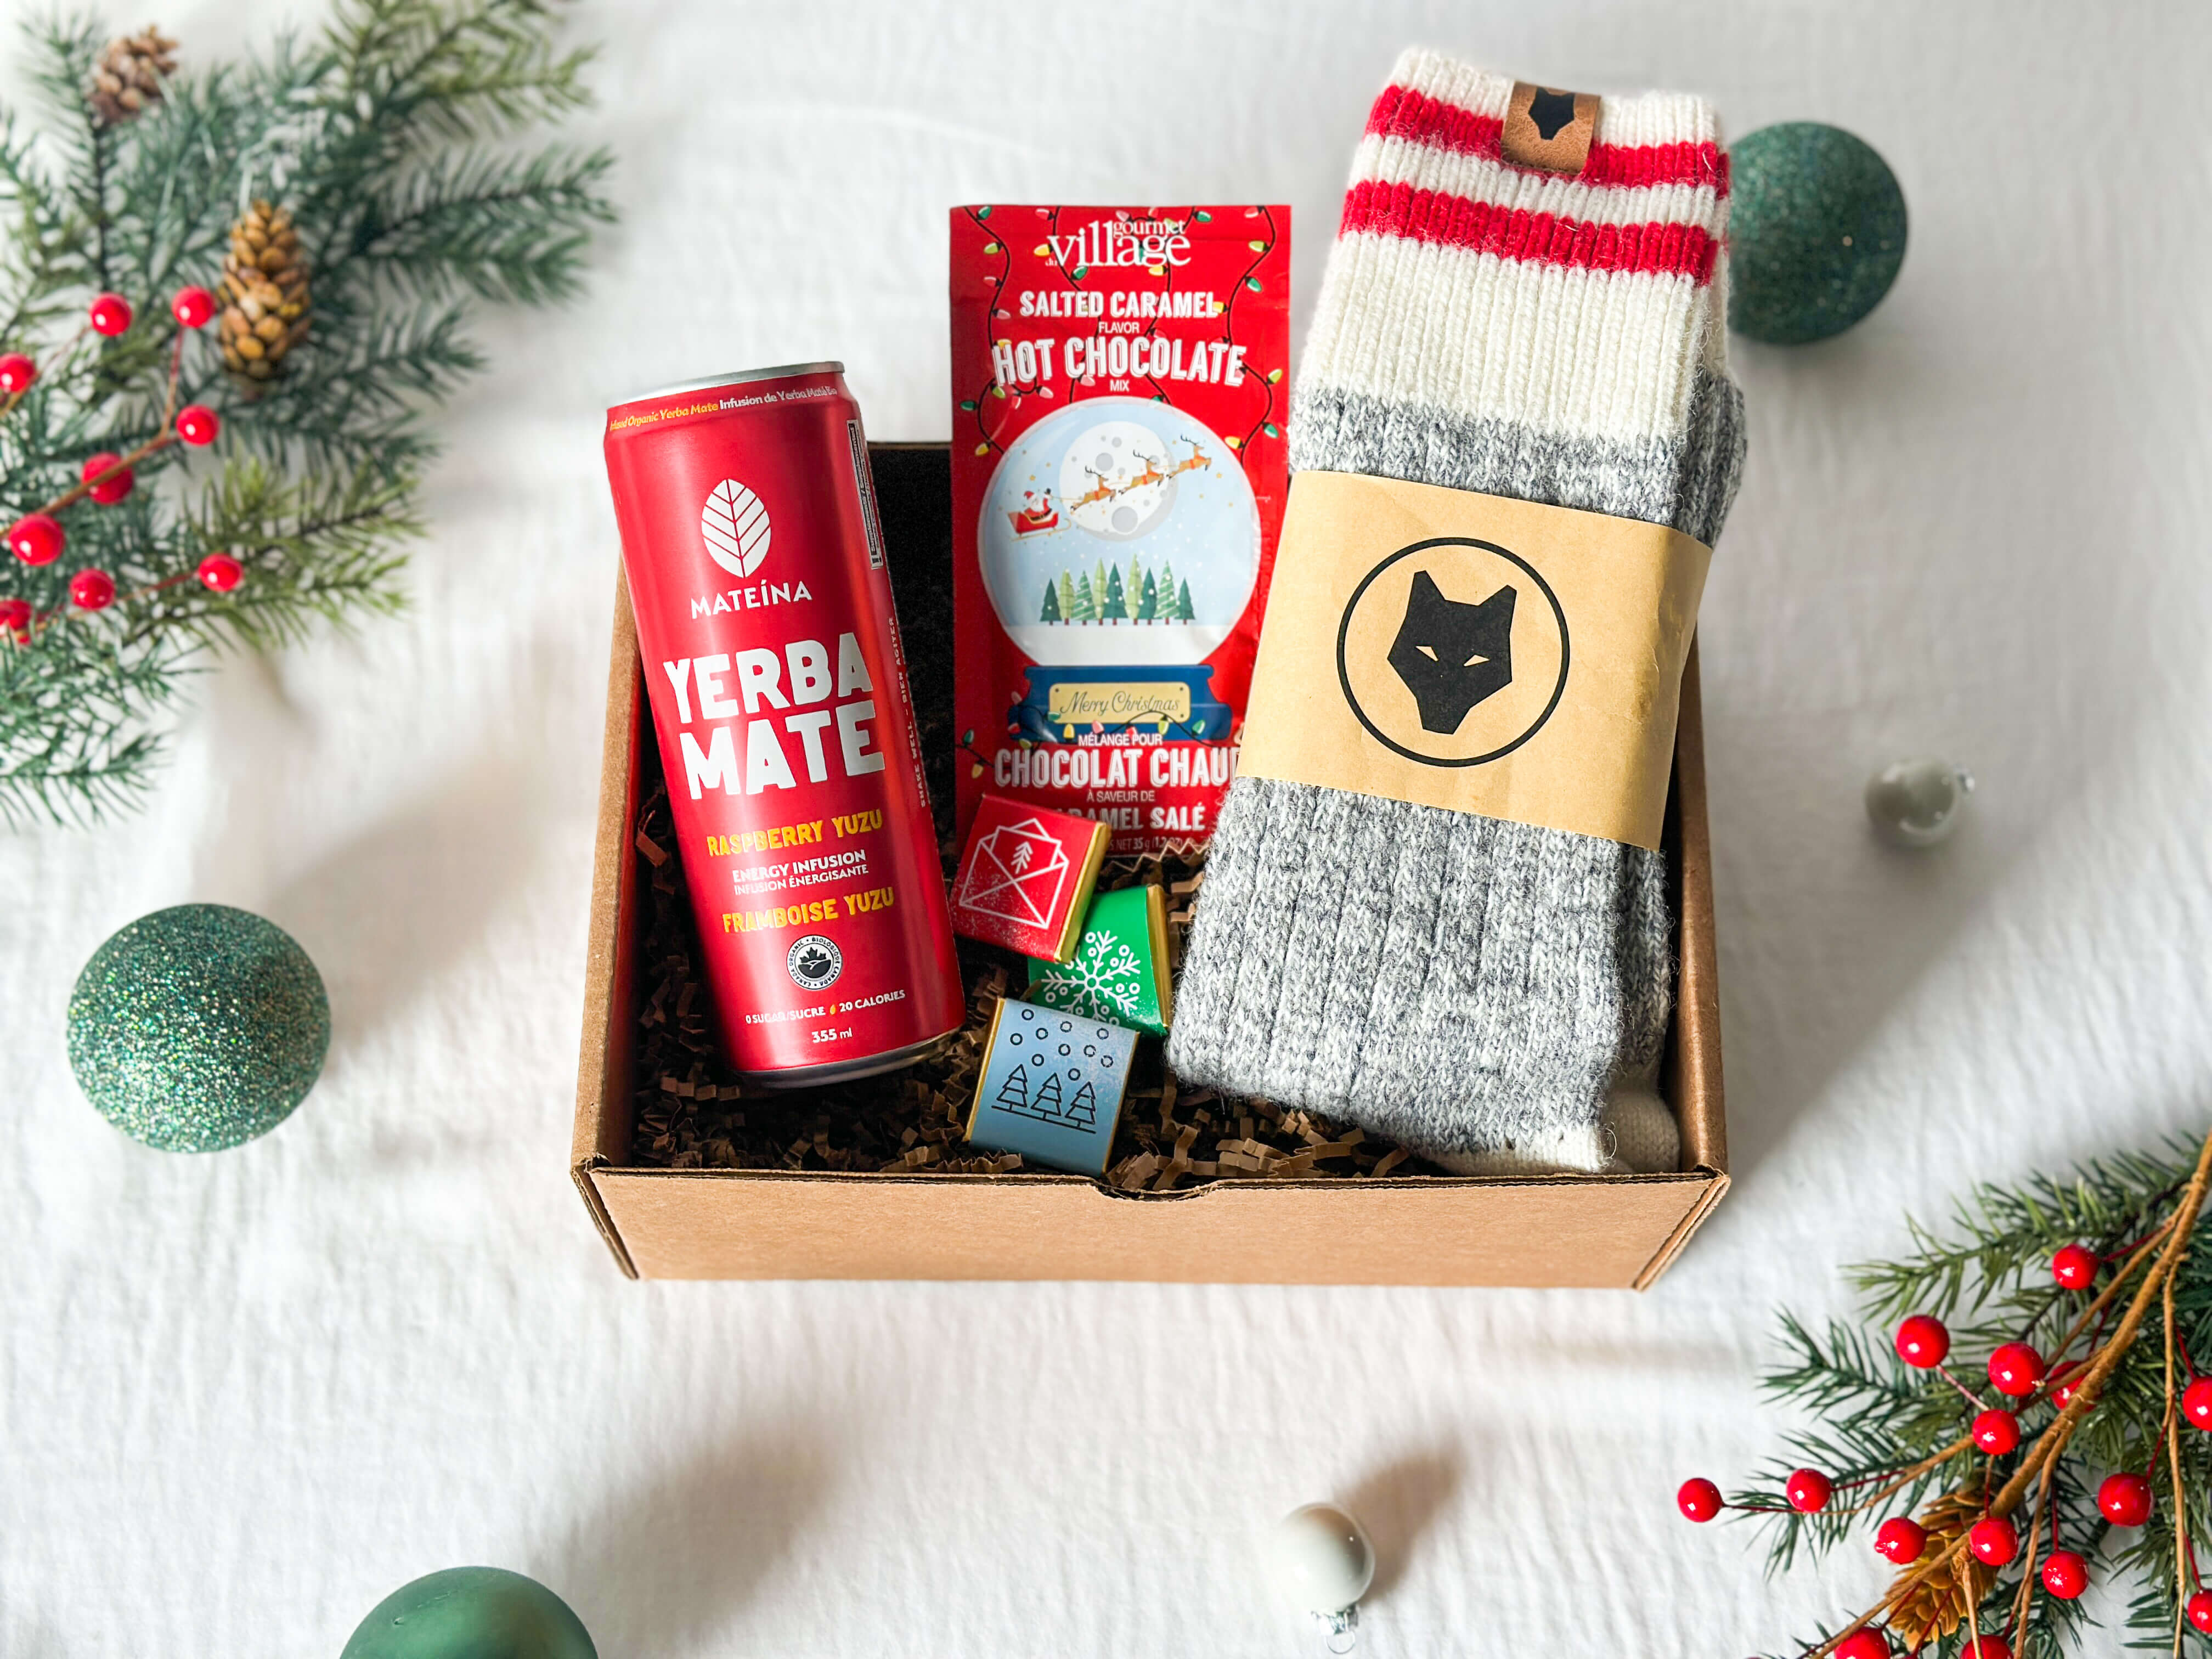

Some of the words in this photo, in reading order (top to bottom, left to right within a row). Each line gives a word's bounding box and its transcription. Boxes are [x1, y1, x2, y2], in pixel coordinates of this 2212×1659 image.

[1047, 220, 1192, 267] village
[1113, 219, 1186, 239] gourmet
[1020, 290, 1104, 318] SALTED
[1110, 291, 1218, 319] CARAMEL
[1098, 321, 1140, 334] FLAVOR
[992, 338, 1055, 387] HOT
[1065, 336, 1247, 387] CHOCOLATE
[1110, 380, 1130, 392] MIX
[659, 407, 690, 420] Yerba
[691, 403, 719, 415] Mate
[720, 396, 763, 410] Infusion
[764, 393, 778, 403] de
[691, 579, 812, 619] MATEÍNA
[663, 632, 874, 724] YERBA
[1060, 691, 1109, 716] Merry
[1111, 691, 1180, 712] Christmas
[679, 699, 885, 800] MATE
[1078, 732, 1130, 746] MÉLANGE
[1132, 733, 1163, 746] POUR
[994, 748, 1143, 788] CHOCOLAT
[1086, 788, 1094, 802] À
[1097, 791, 1139, 803] SAVEUR
[1141, 791, 1155, 802] DE
[1150, 802, 1206, 831] SALÉ
[707, 820, 823, 856] RASPBERRY
[831, 809, 883, 838] YUZU
[1133, 837, 1143, 849] 35
[732, 863, 789, 883] ENERGY
[793, 849, 866, 875] INFUSION
[734, 878, 787, 896] INFUSION
[789, 864, 869, 888] ÉNERGISANTE
[723, 899, 839, 933] FRAMBOISE
[844, 887, 895, 916] YUZU
[839, 1002, 853, 1013] 20
[855, 989, 905, 1009] CALORIES
[811, 1029, 837, 1043] 355
[840, 1028, 853, 1040] ml
